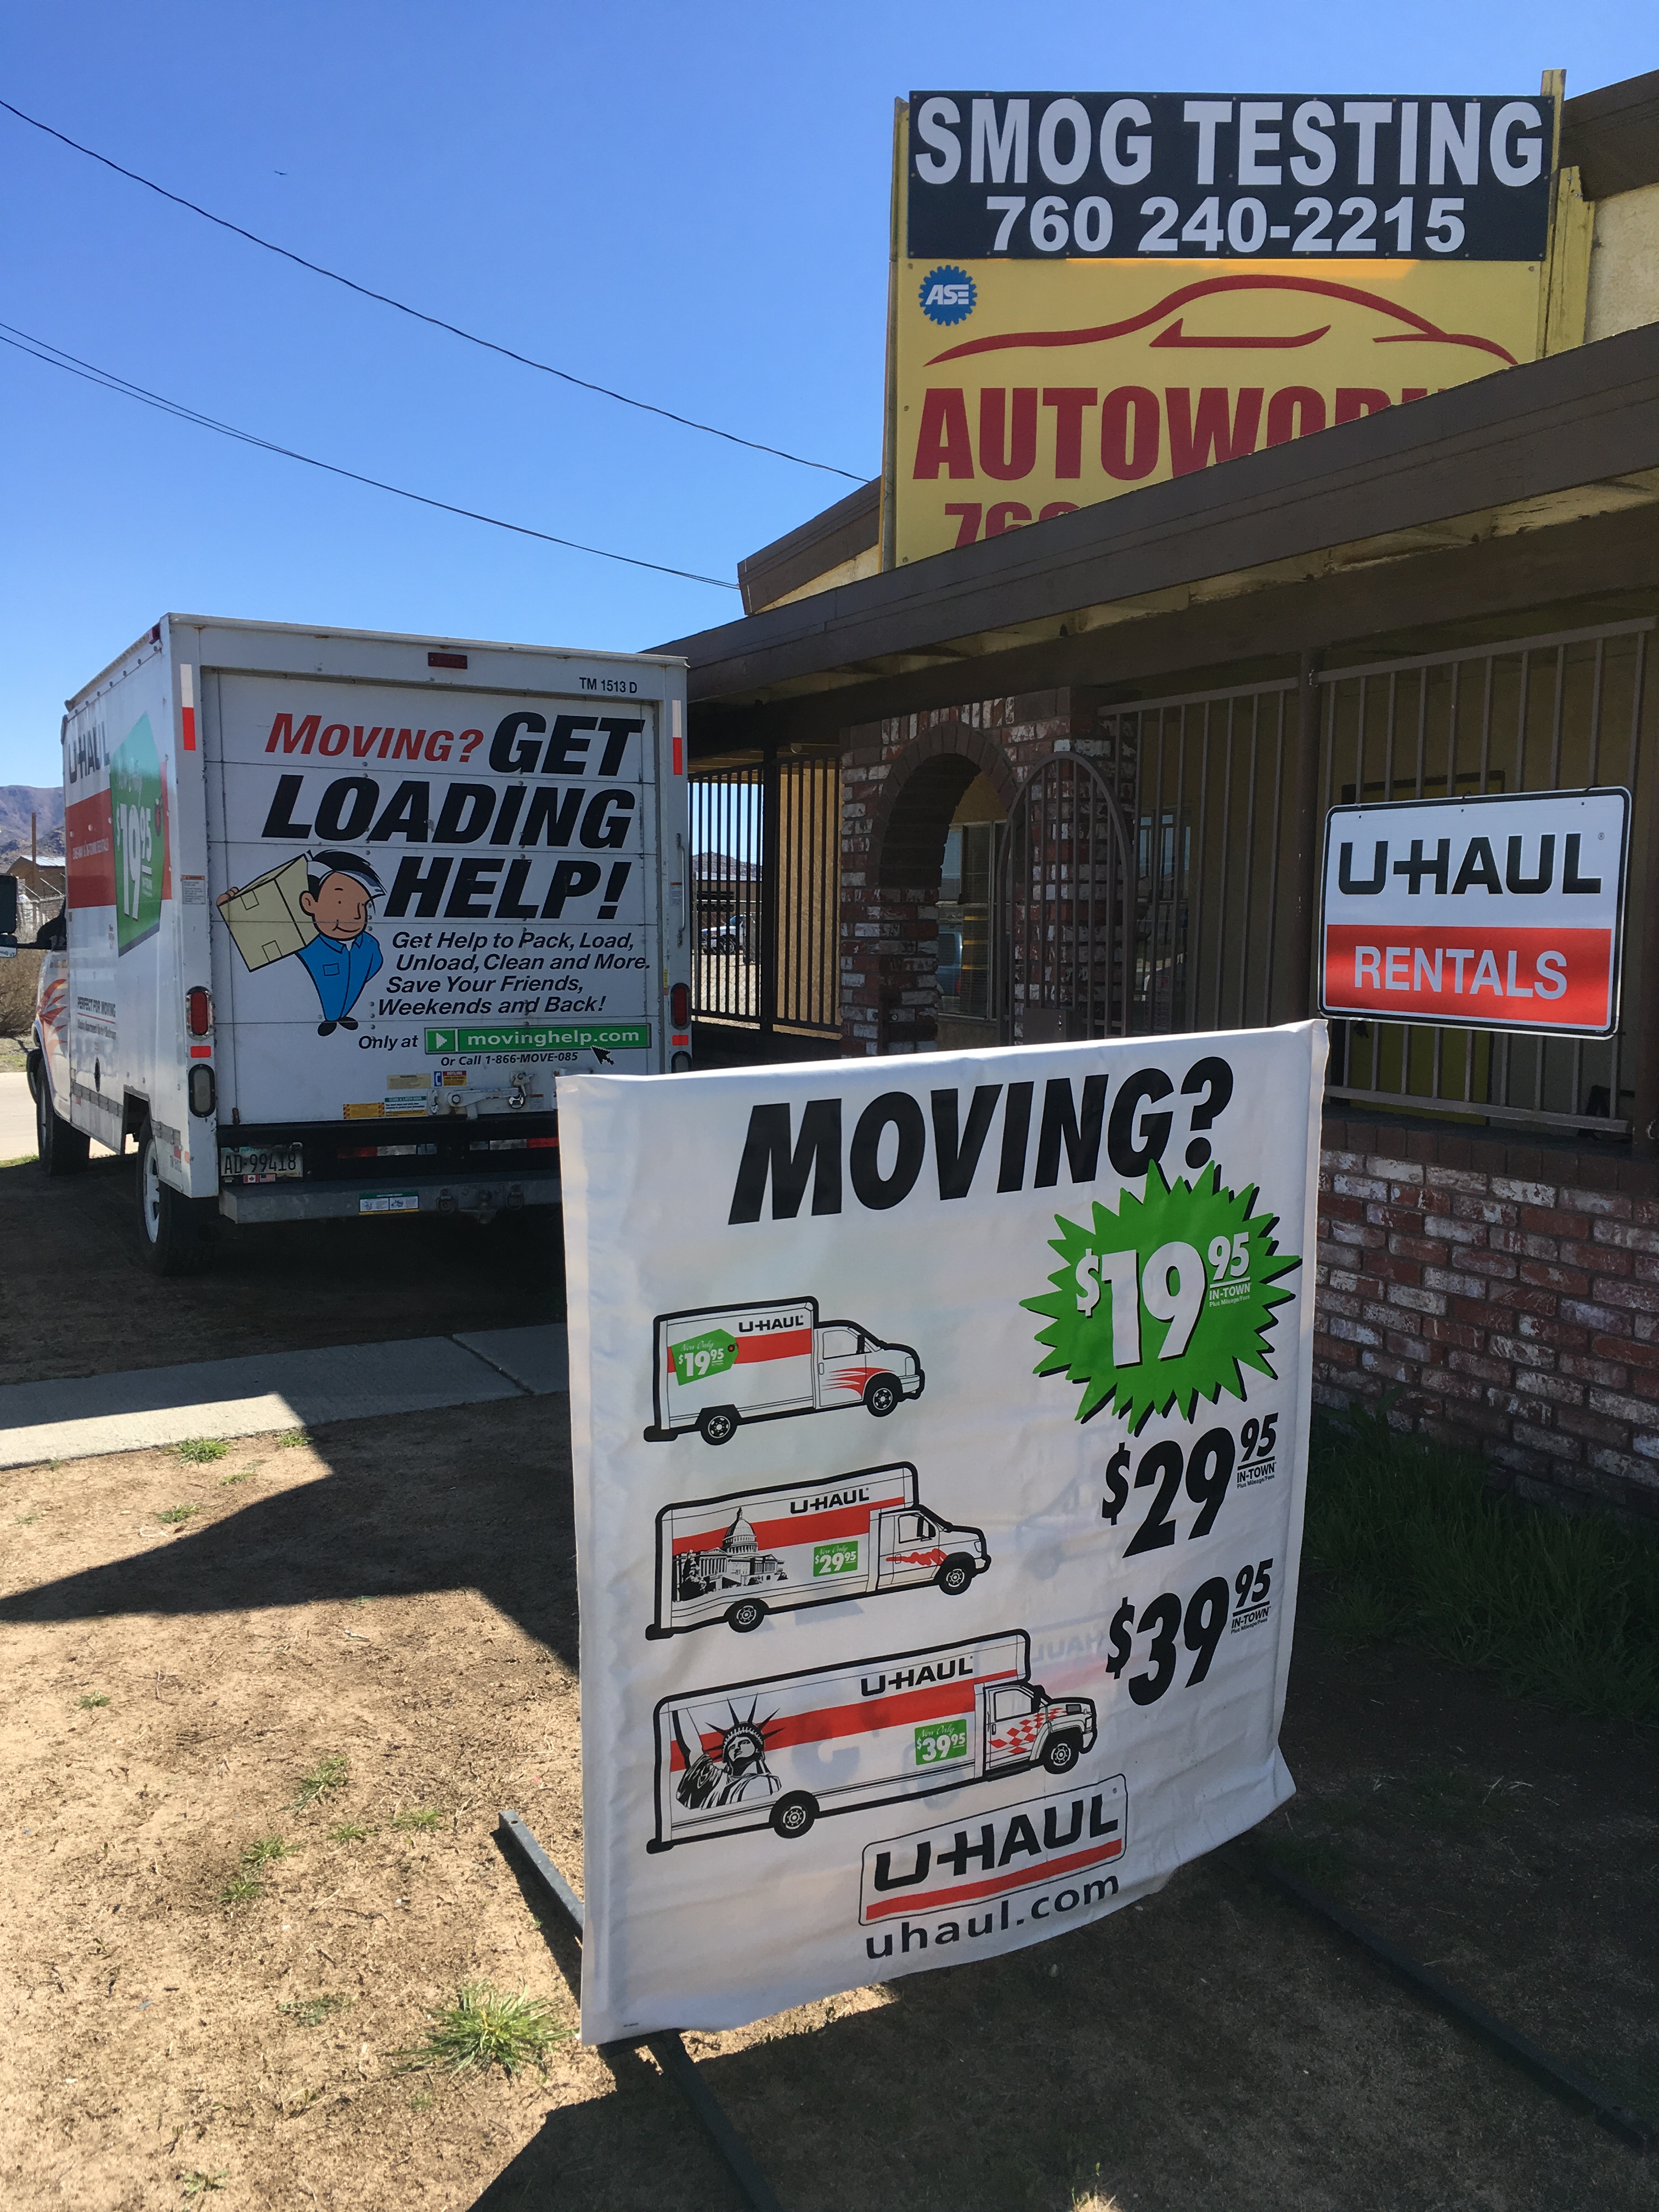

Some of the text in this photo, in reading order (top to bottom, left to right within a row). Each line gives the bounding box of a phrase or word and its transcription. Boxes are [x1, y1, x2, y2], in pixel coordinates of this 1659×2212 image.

[915, 97, 1544, 188] SMOG TESTING
[986, 195, 1466, 253] 760 240-2215
[925, 284, 969, 305] ASE
[912, 386, 1446, 481] AUTOWO
[579, 677, 637, 693] TM 1513 D
[264, 712, 646, 776] MOVING? GET
[261, 774, 636, 849] LOADING
[1338, 833, 1602, 895] U-HAUL
[383, 855, 633, 919] HELP!
[392, 932, 634, 954] Get Help to Pack, Load,
[396, 953, 651, 973] Unload, Clean and More.
[1354, 946, 1568, 1000] RENTALS
[386, 975, 583, 994] Save Your Friends,
[378, 996, 606, 1016] Weekends and Back!
[358, 1035, 419, 1052] Only at
[467, 1029, 640, 1047] movinghelp.com
[440, 1057, 456, 1067] Or
[459, 1054, 481, 1066] Call
[729, 1056, 1234, 1226] MOVING?
[1209, 1283, 1251, 1301] IN-TOWN
[738, 1316, 804, 1333] U-HAUL
[696, 1340, 714, 1351] Only
[1237, 1462, 1276, 1483] IN-TOWN
[790, 1488, 870, 1514] U-HAUL
[1231, 1606, 1269, 1629] IN-TOWN
[861, 1657, 973, 1697] U-HAUL
[874, 1793, 1119, 1892] U-HAUL
[866, 1872, 1119, 1960] uhaul.com
